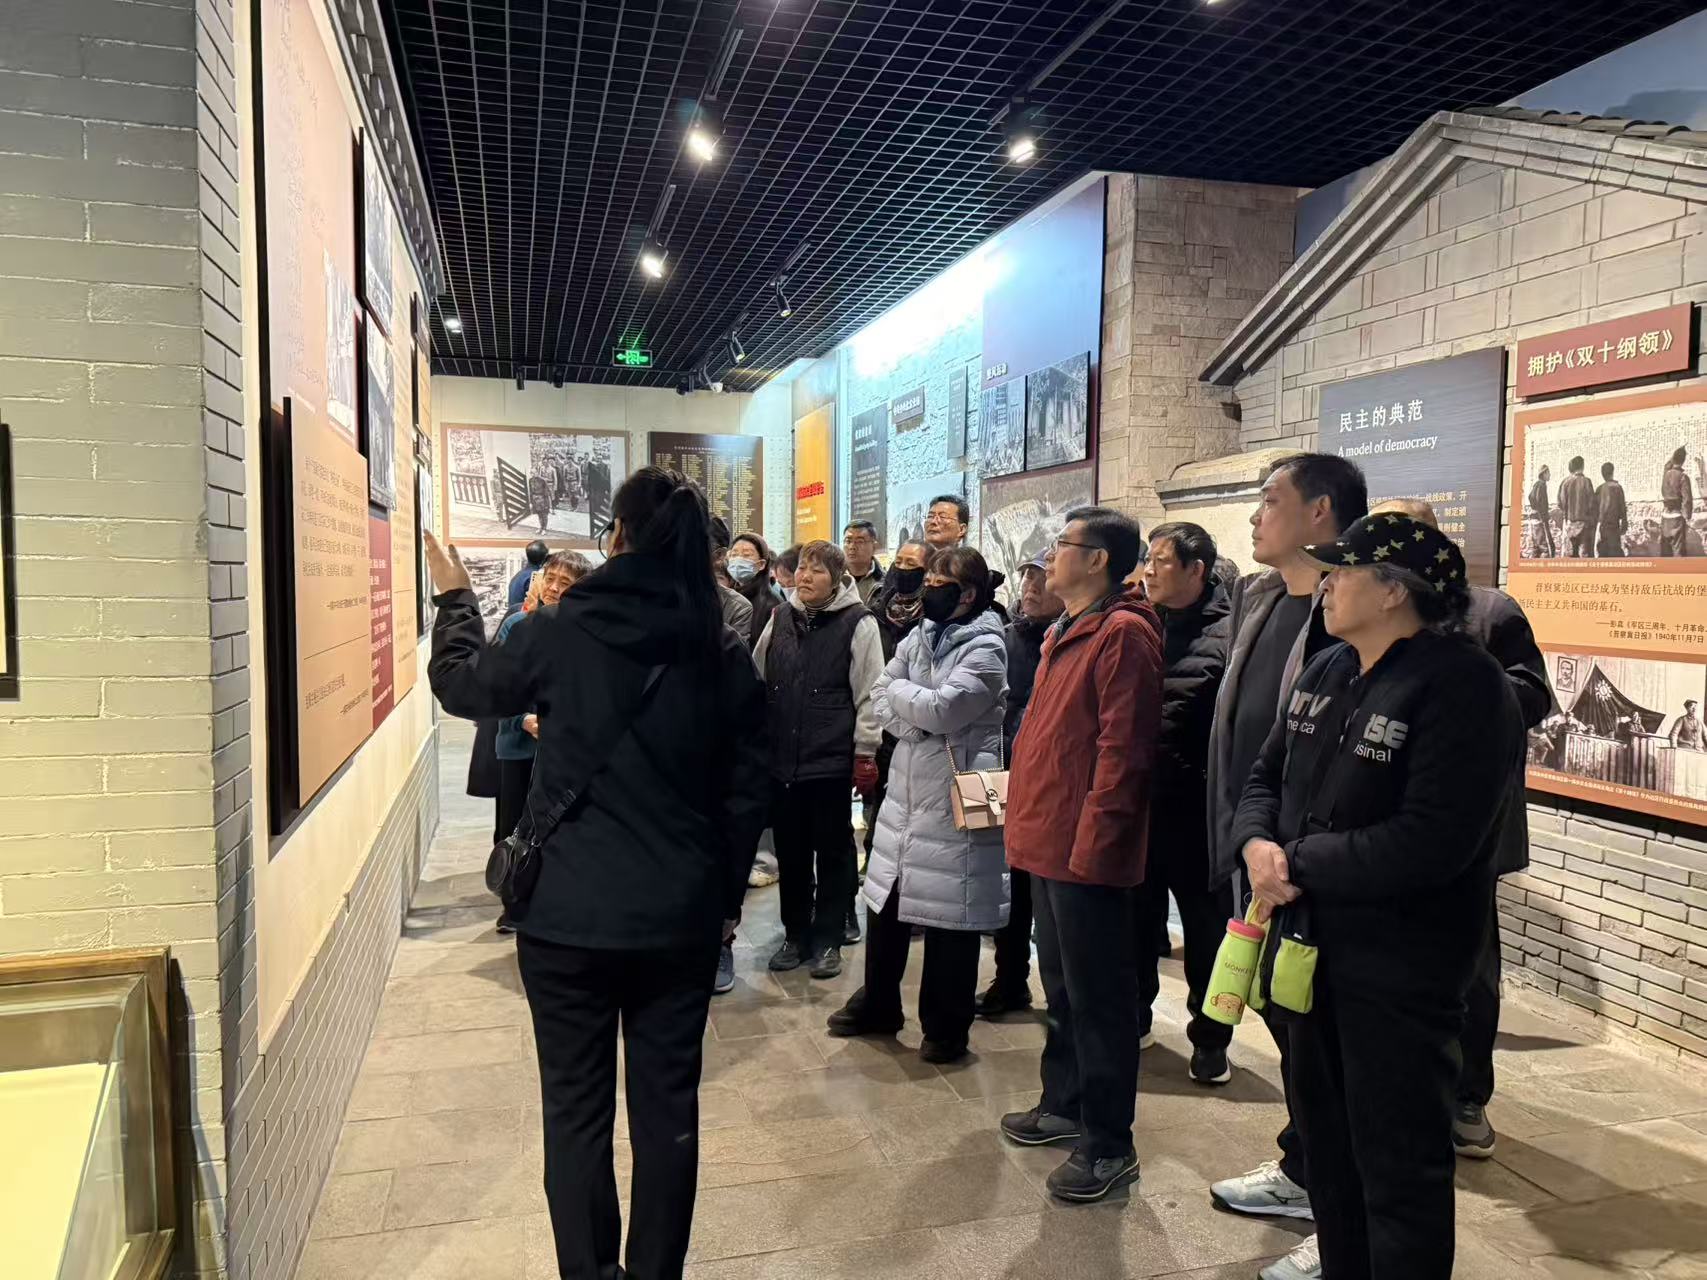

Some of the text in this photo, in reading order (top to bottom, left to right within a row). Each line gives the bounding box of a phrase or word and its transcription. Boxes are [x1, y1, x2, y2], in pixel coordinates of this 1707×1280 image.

[1528, 329, 1673, 377] 拥护《双十纲领》
[1340, 399, 1423, 433] 民主的典范
[1338, 435, 1438, 458] A model of democracy
